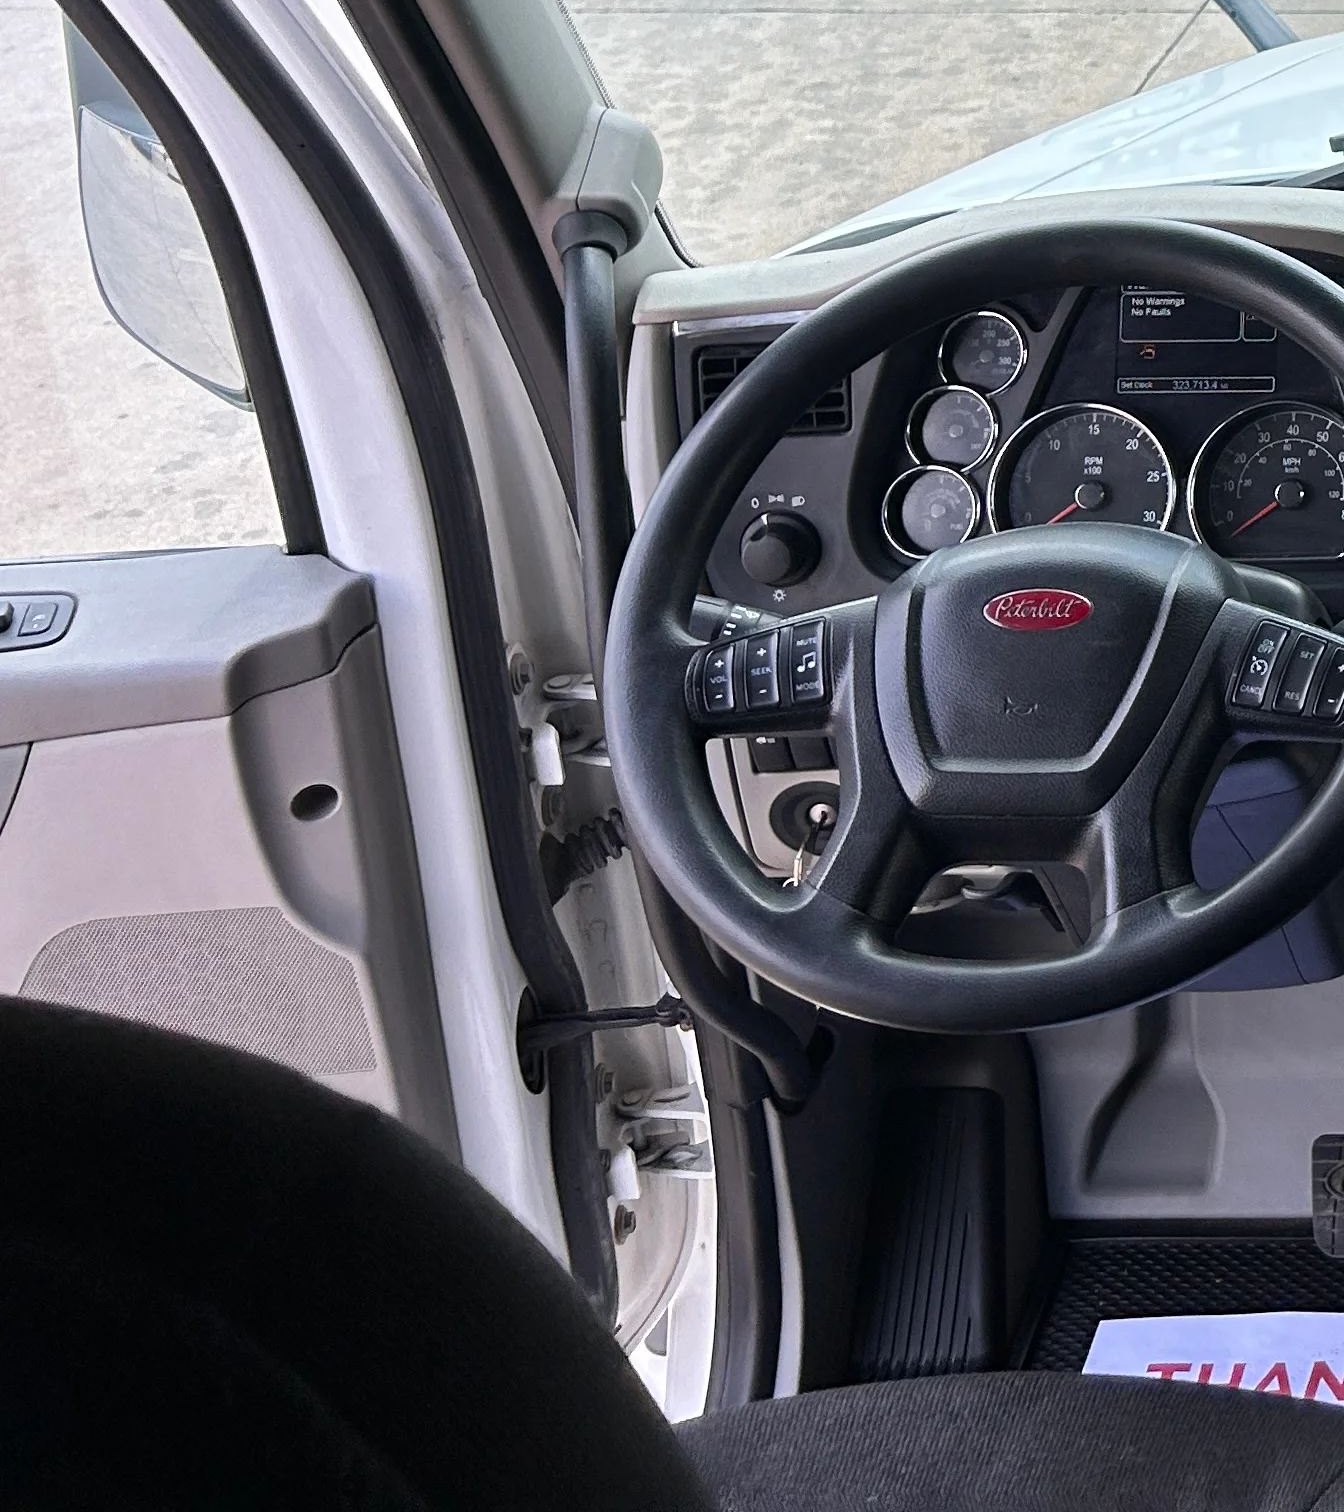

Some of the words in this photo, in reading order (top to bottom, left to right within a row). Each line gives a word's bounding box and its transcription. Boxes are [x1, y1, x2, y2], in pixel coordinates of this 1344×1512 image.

[1131, 297, 1144, 306] No
[1146, 297, 1186, 307] Warnings
[1131, 308, 1144, 317] No
[1145, 308, 1172, 317] Faults
[1088, 424, 1100, 436] 15
[1286, 424, 1299, 436] 40
[1257, 432, 1271, 443] 30
[1316, 431, 1329, 443] 50
[1050, 439, 1060, 451] 10
[1125, 438, 1139, 450] 20
[1084, 456, 1103, 466] RPM
[1233, 452, 1247, 464] 20
[1282, 457, 1301, 467] MPH
[1083, 466, 1102, 475] x100
[1146, 471, 1160, 483] 25
[1223, 480, 1235, 492] 10
[1143, 510, 1156, 522] 30
[994, 596, 1082, 620] Peterbilt
[796, 636, 818, 647] MUTE
[1300, 650, 1316, 661] SET
[710, 675, 728, 685] VOL
[1284, 690, 1300, 701] RES
